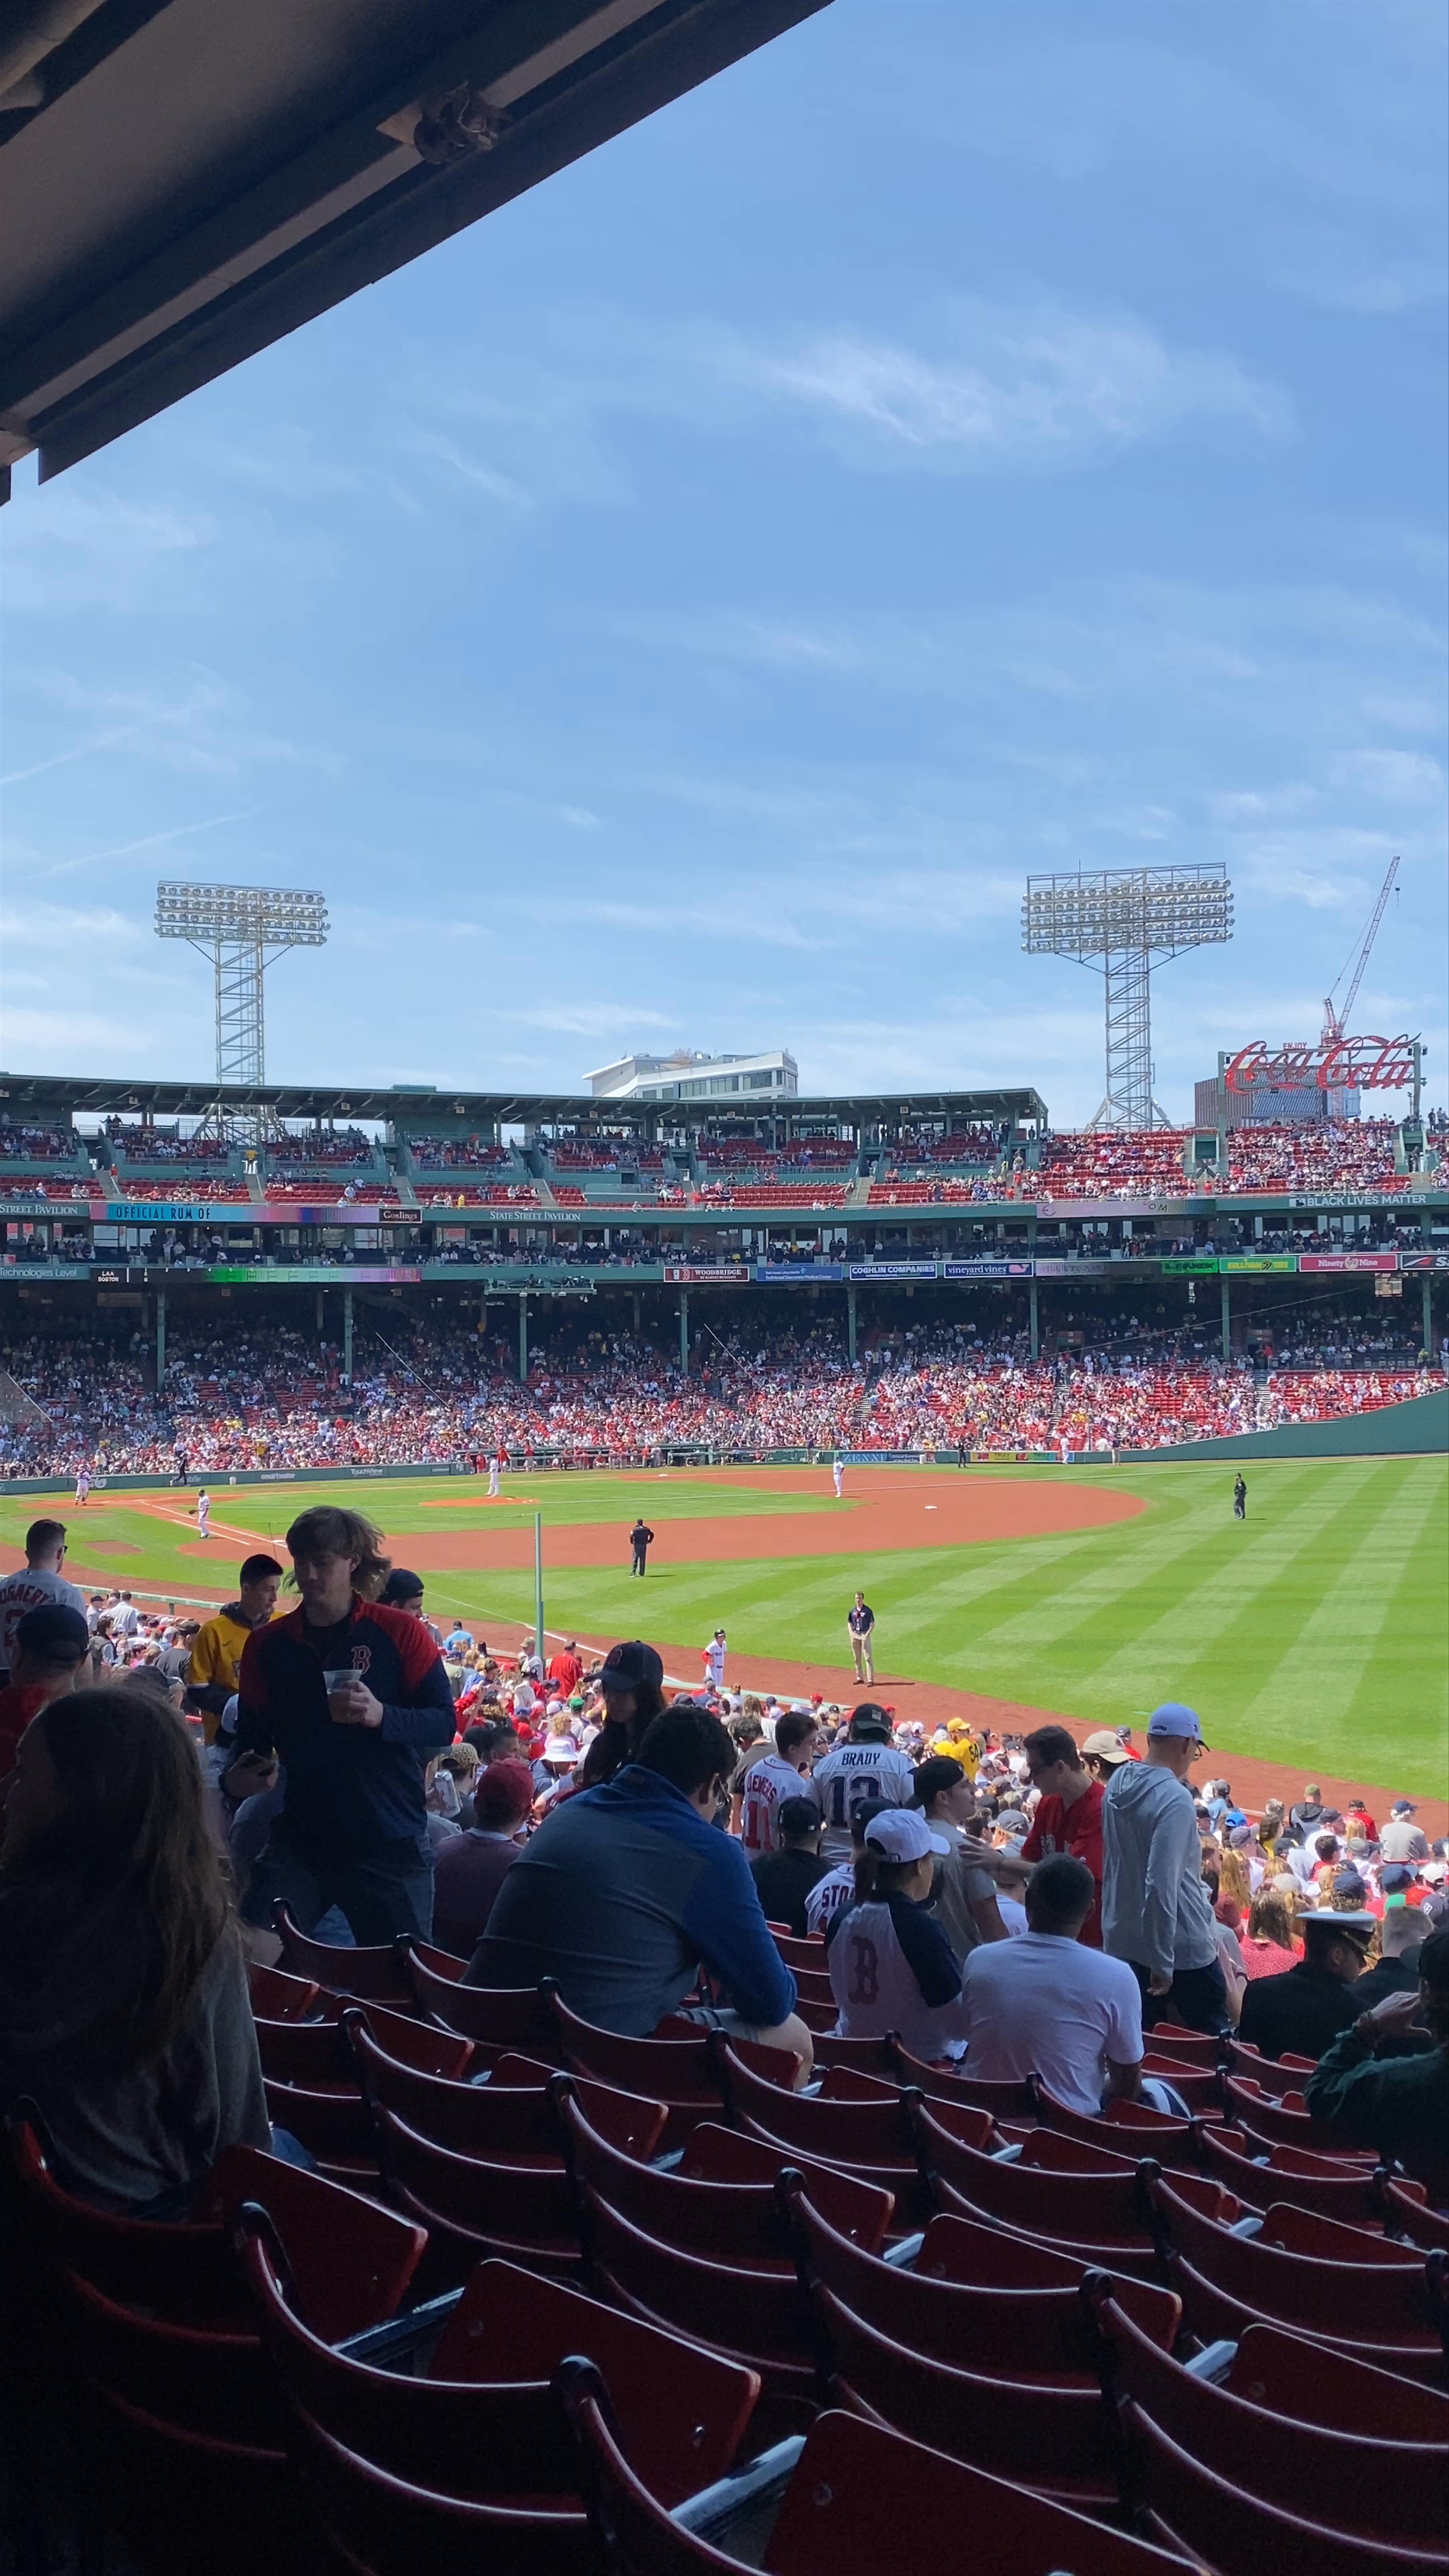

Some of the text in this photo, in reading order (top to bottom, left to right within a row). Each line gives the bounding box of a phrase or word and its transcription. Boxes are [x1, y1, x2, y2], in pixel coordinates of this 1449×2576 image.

[1307, 1194, 1426, 1206] BLACK LIVES MATTER
[35, 1204, 78, 1215] PAVILION
[117, 1206, 211, 1219] OFFICIAL RUM OF
[383, 1210, 417, 1221] Goslings
[490, 1212, 581, 1221] STATE STREET PAVILION
[1318, 1259, 1344, 1268] Ninety
[0, 1268, 77, 1278] Technologies Level
[948, 1265, 983, 1275] vineyard
[841, 1752, 880, 1766] BRADY
[746, 1775, 777, 1805] DEVERS
[831, 1776, 880, 1828] 12
[745, 1800, 774, 1852] 11
[848, 1935, 880, 2006] B
